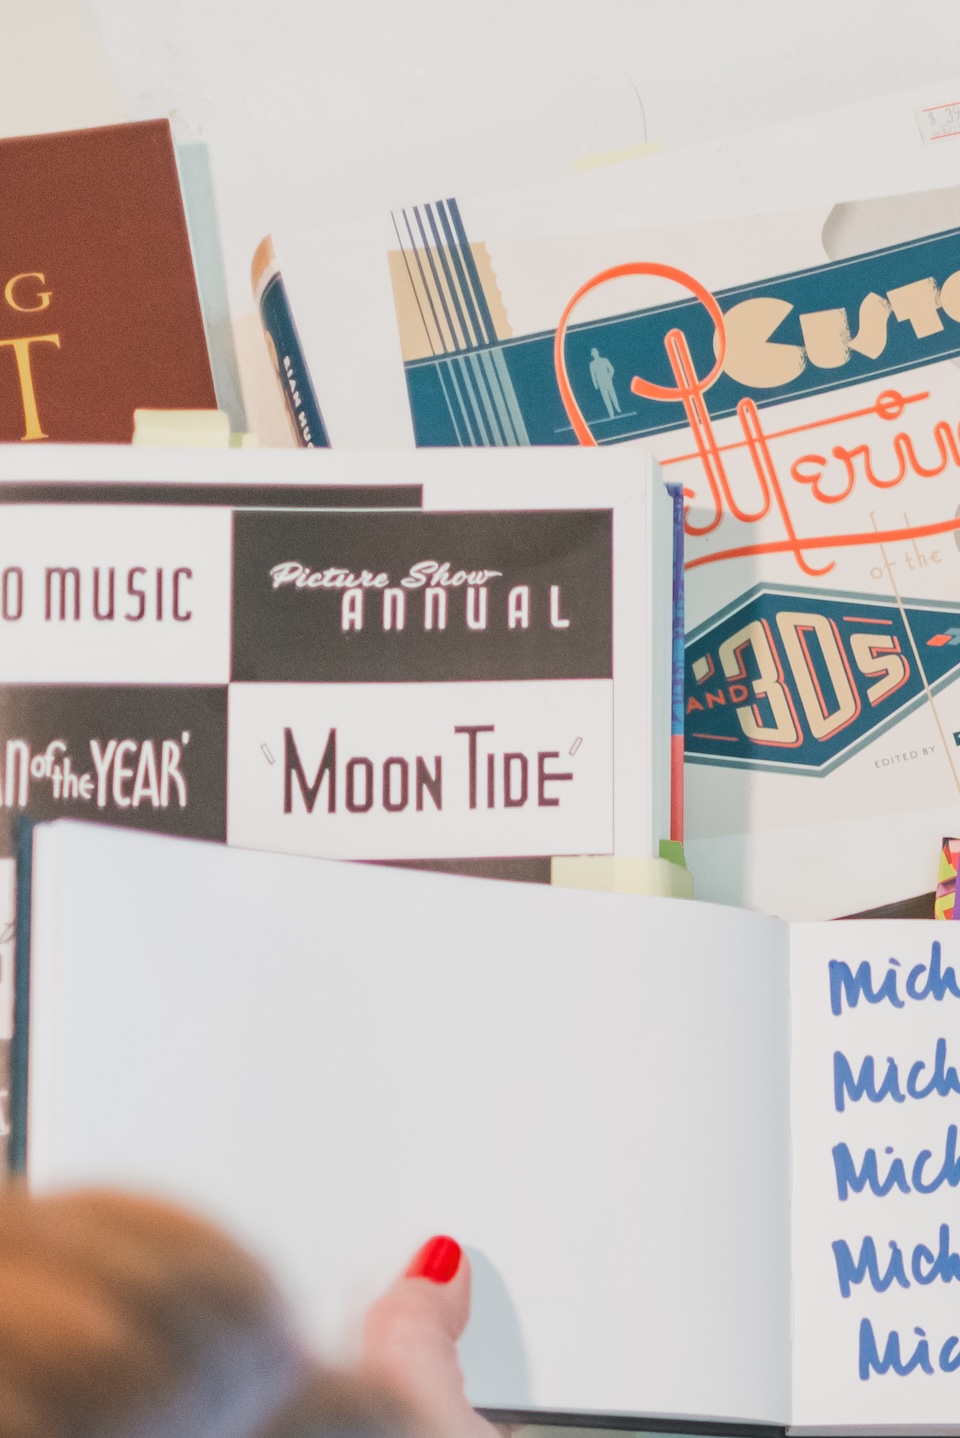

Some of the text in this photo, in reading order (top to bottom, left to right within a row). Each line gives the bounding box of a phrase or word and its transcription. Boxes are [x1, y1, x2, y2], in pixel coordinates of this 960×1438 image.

[270, 560, 502, 588] Picture Show
[686, 684, 749, 714] AND
[874, 750, 918, 769] EDITED
[922, 745, 937, 757] BY
